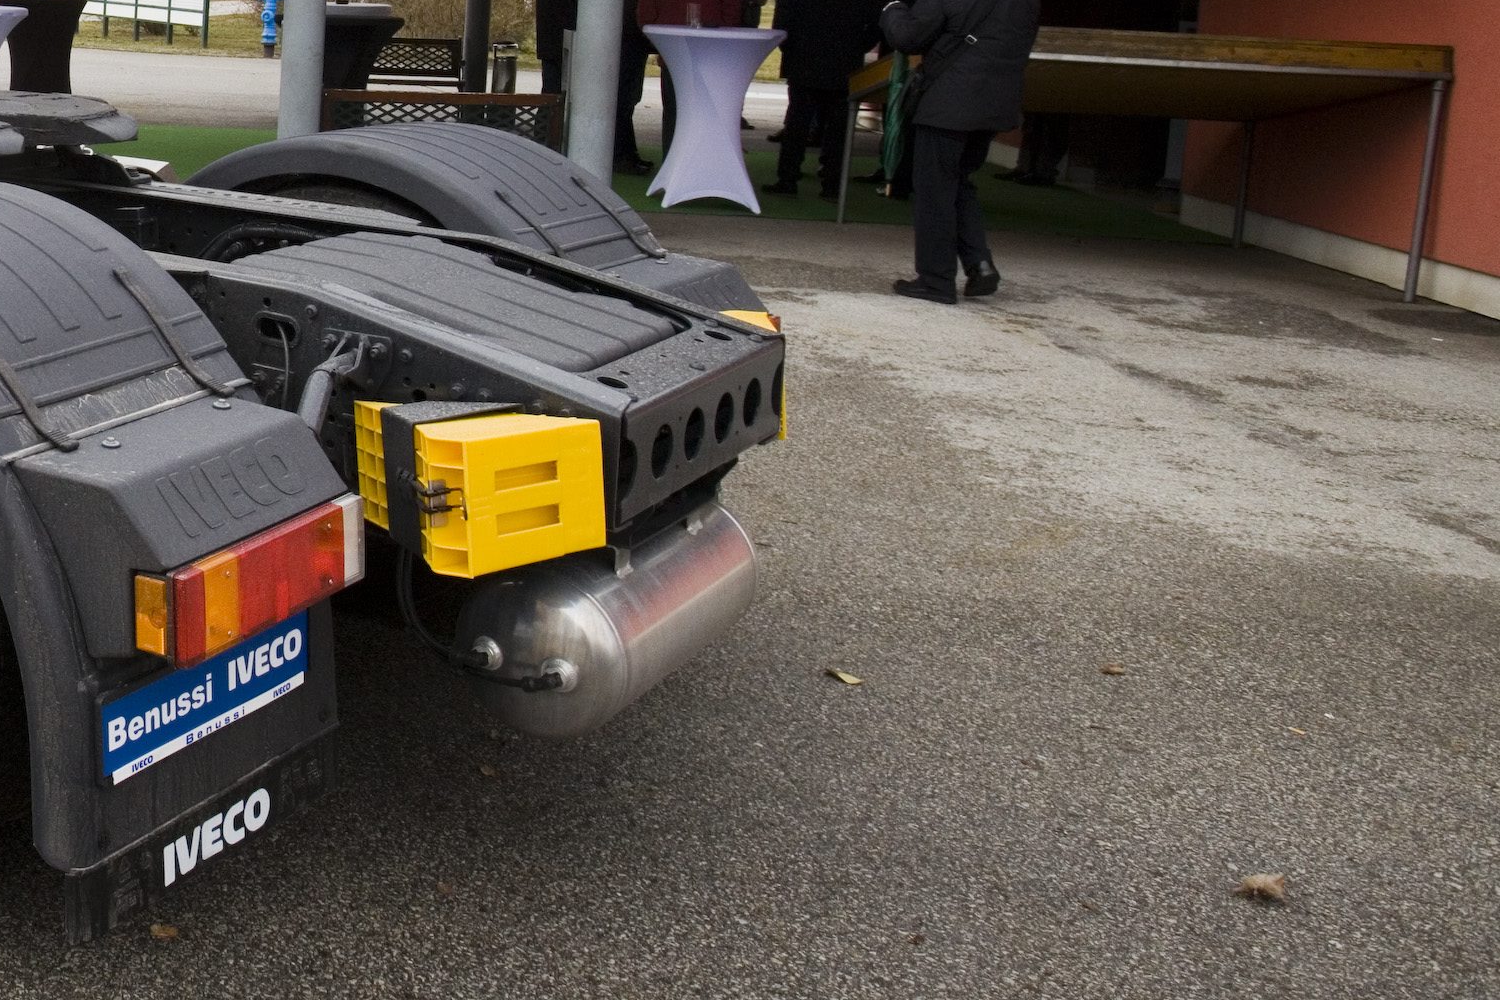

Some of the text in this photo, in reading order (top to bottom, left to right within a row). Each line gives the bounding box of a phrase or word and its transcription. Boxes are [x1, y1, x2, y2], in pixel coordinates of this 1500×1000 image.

[155, 436, 308, 538] IVECO
[108, 628, 302, 752] Benussi IVECO
[131, 682, 291, 773] IVECO Benussi IVECO
[163, 788, 270, 888] IVECO
